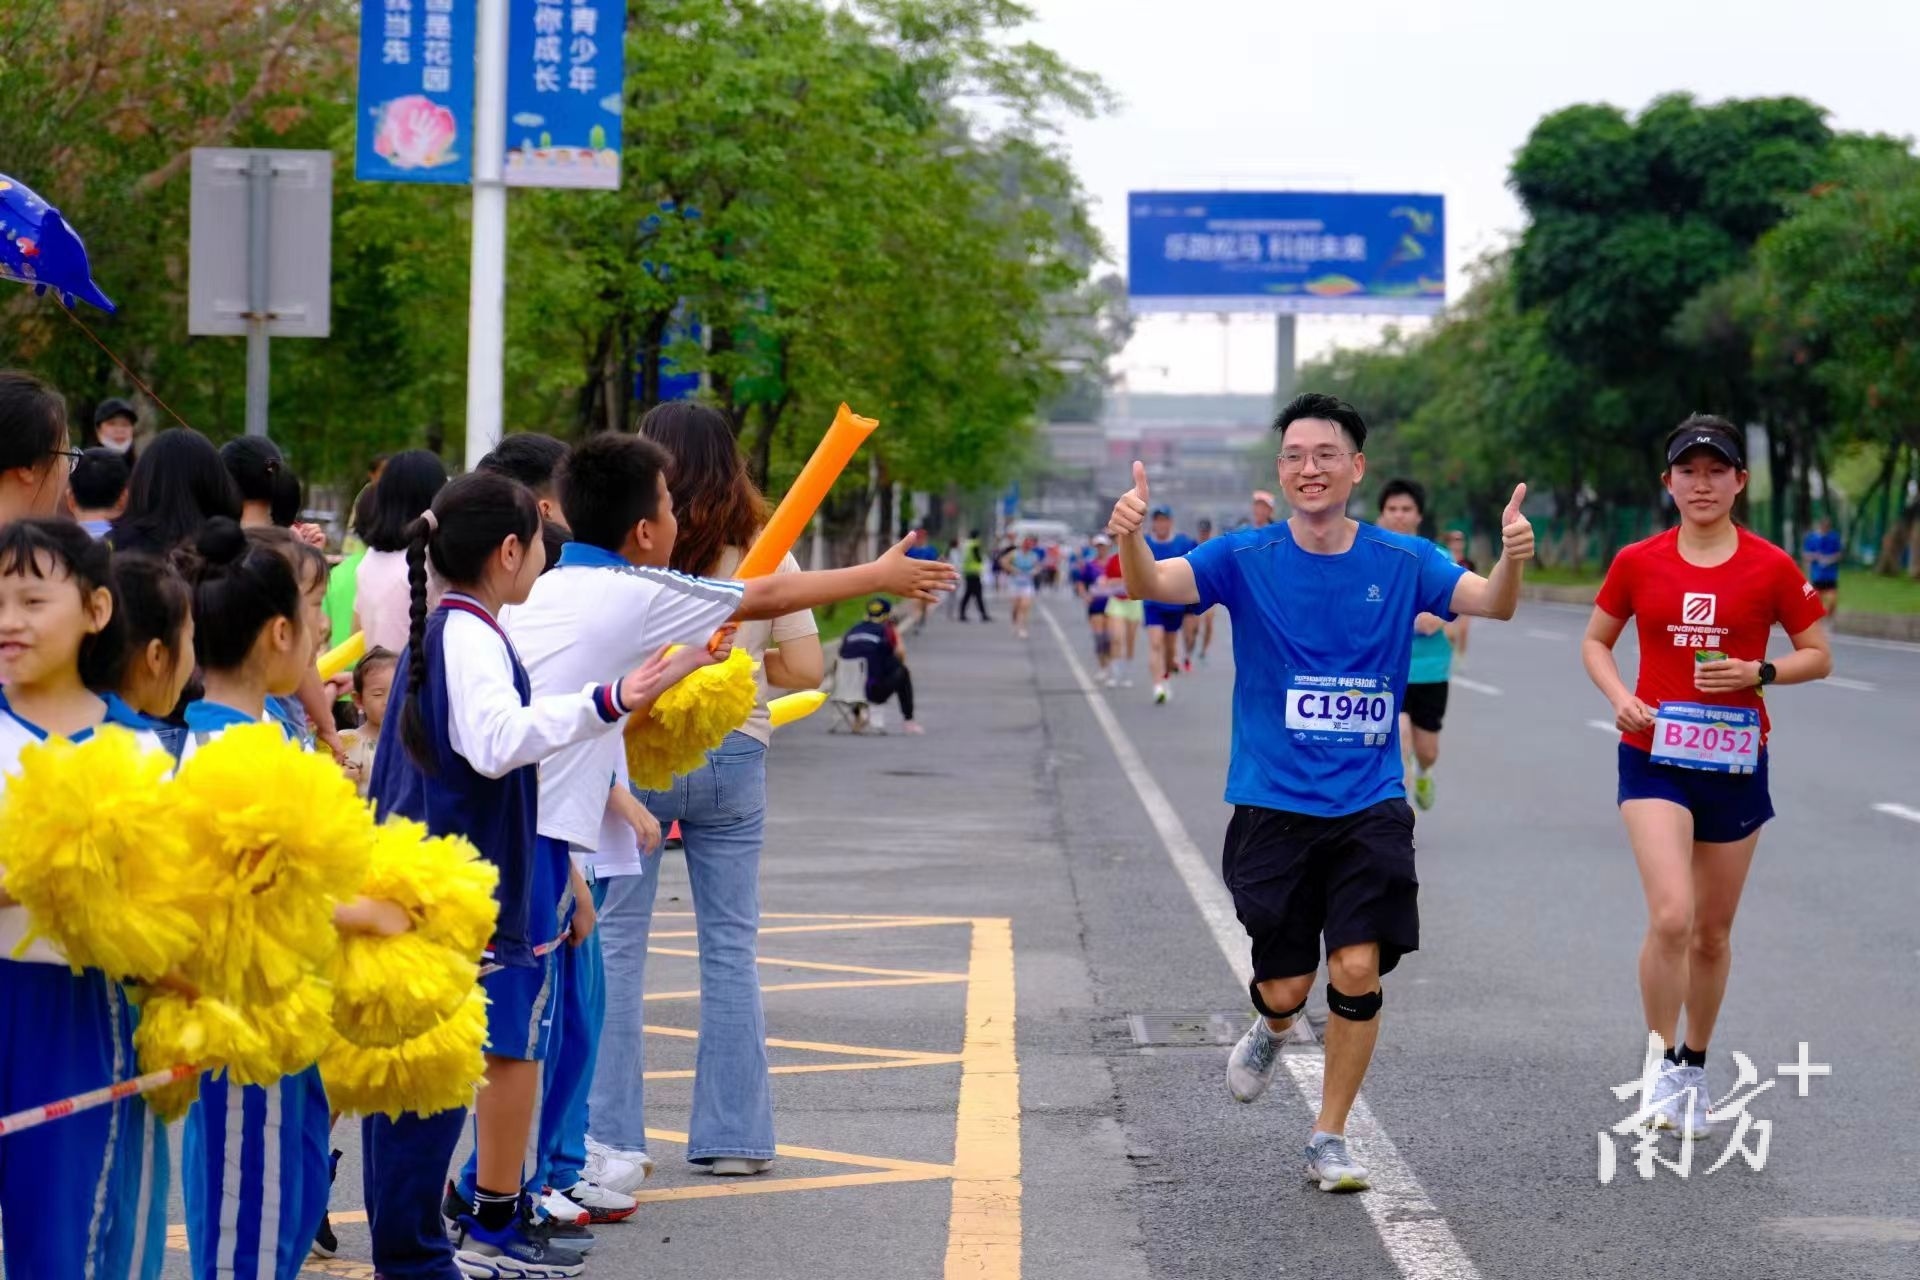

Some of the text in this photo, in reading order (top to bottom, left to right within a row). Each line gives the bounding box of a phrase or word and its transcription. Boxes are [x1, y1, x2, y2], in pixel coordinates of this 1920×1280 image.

[533, 0, 564, 92] 你成长
[568, 0, 598, 93] 青少年
[1666, 624, 1729, 635] ENGINEBIRD
[1297, 693, 1386, 722] C1940
[1664, 722, 1753, 754] B2052
